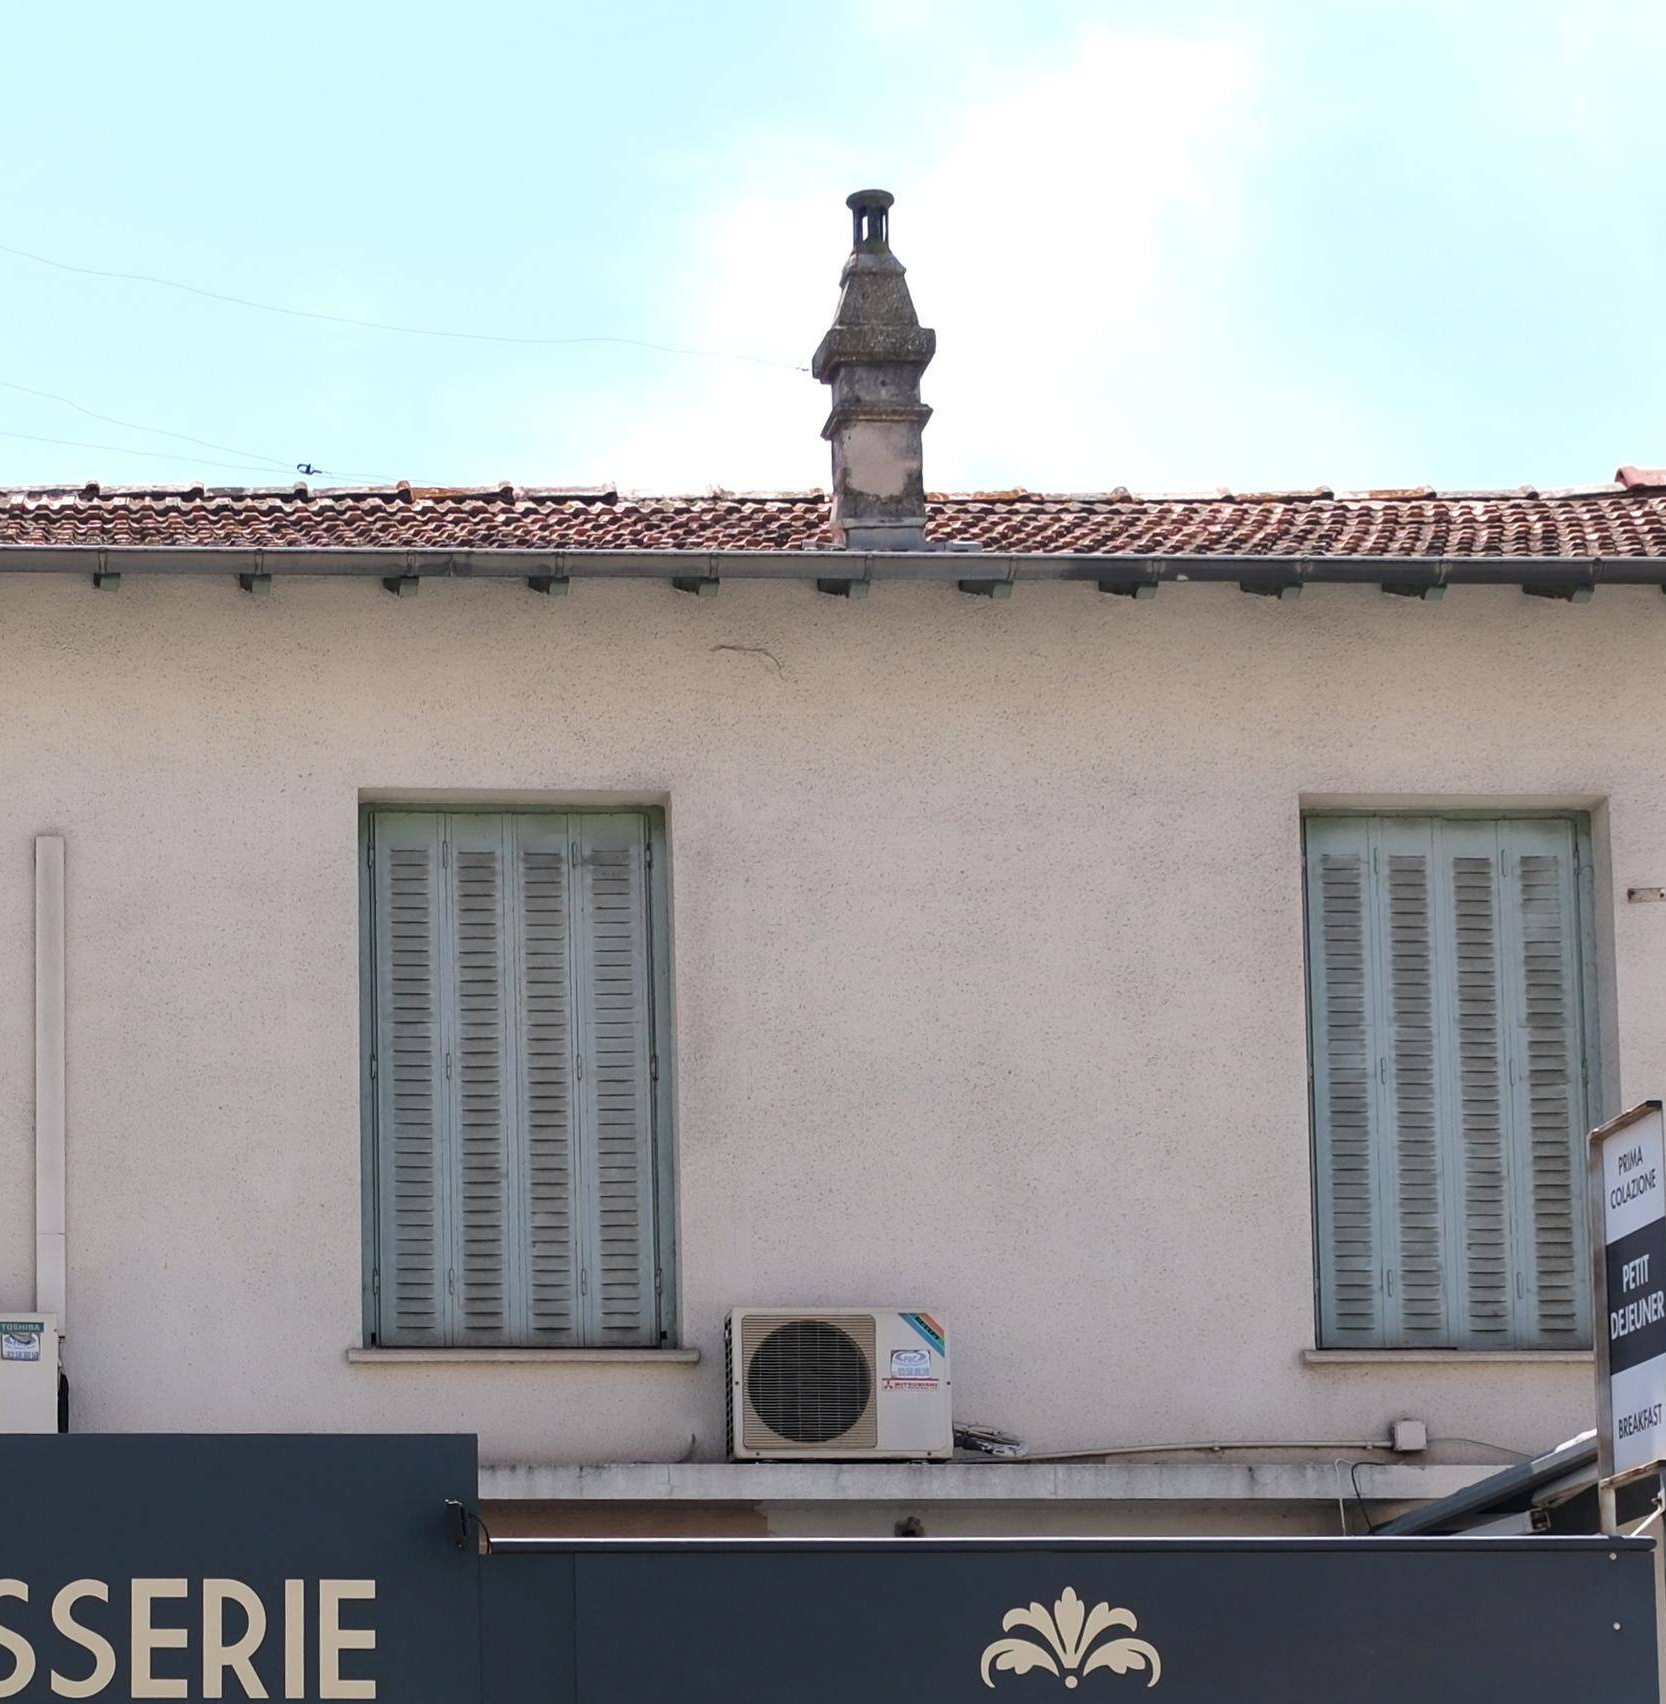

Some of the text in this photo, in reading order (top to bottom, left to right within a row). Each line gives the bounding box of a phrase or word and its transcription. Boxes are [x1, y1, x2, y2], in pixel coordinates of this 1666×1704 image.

[1617, 1146, 1643, 1176] PRIMA
[1610, 1168, 1657, 1209] COLAZIONE
[1622, 1254, 1650, 1292] PETIT
[0, 1323, 41, 1331] TOSHIBA
[1610, 1291, 1665, 1341] DEJEUNER
[1618, 1403, 1663, 1439] BREAKFAST
